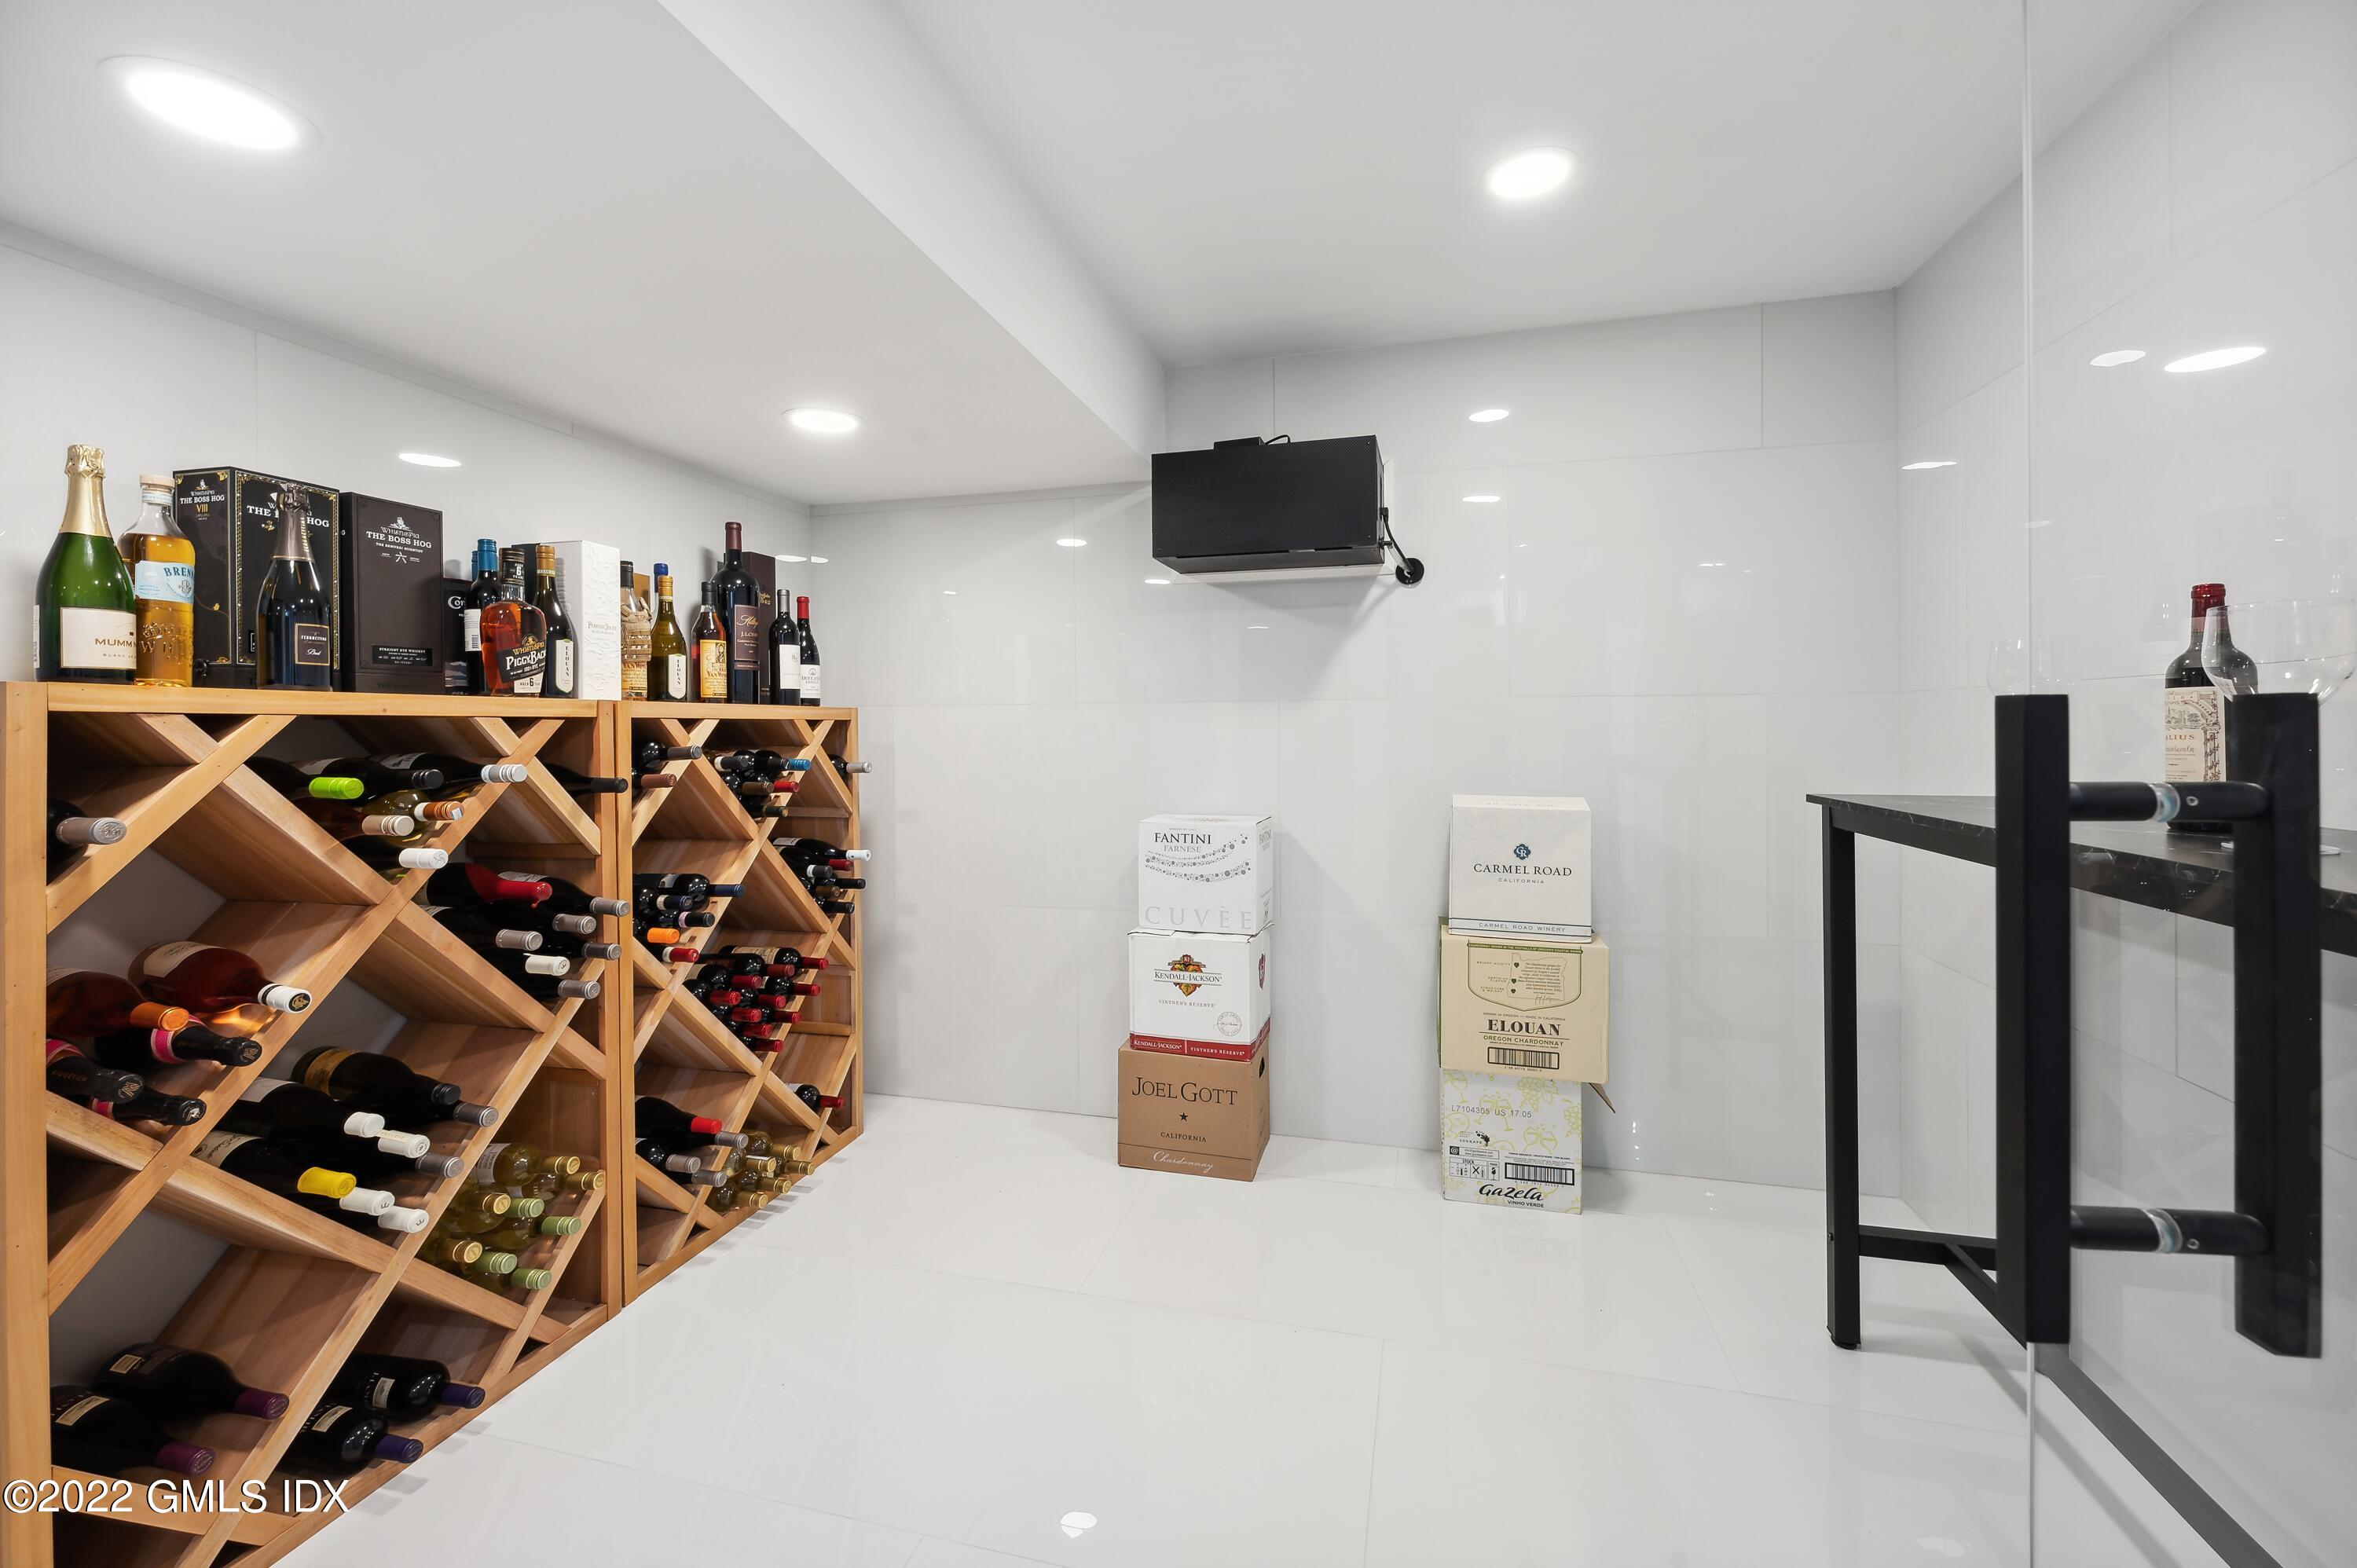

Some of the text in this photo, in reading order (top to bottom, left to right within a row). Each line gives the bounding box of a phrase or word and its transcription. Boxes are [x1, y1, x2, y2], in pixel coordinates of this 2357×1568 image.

[196, 504, 208, 513] VIII
[246, 504, 272, 518] THE
[306, 516, 330, 528] HOG
[366, 530, 432, 549] THE BOSS HOG
[516, 566, 522, 576] 6
[529, 677, 534, 687] 6
[1153, 832, 1211, 844] FANTINI
[1164, 844, 1201, 853] FARNESE
[1473, 863, 1573, 877] CARMEL ROAD
[1154, 971, 1220, 983] KENDALL-JACKSON
[1487, 1019, 1561, 1036] ELOUAN
[1134, 1039, 1179, 1050] KENDALL-JACKSON
[1514, 1038, 1564, 1046] CHARDONNAY
[1132, 1076, 1238, 1105] JOEL GOTT
[1451, 1105, 1490, 1115] L7104305
[1160, 1131, 1208, 1143] CALIFORNIA
[1152, 1149, 1214, 1174] Chardonnay
[1479, 1184, 1545, 1201] Gazela
